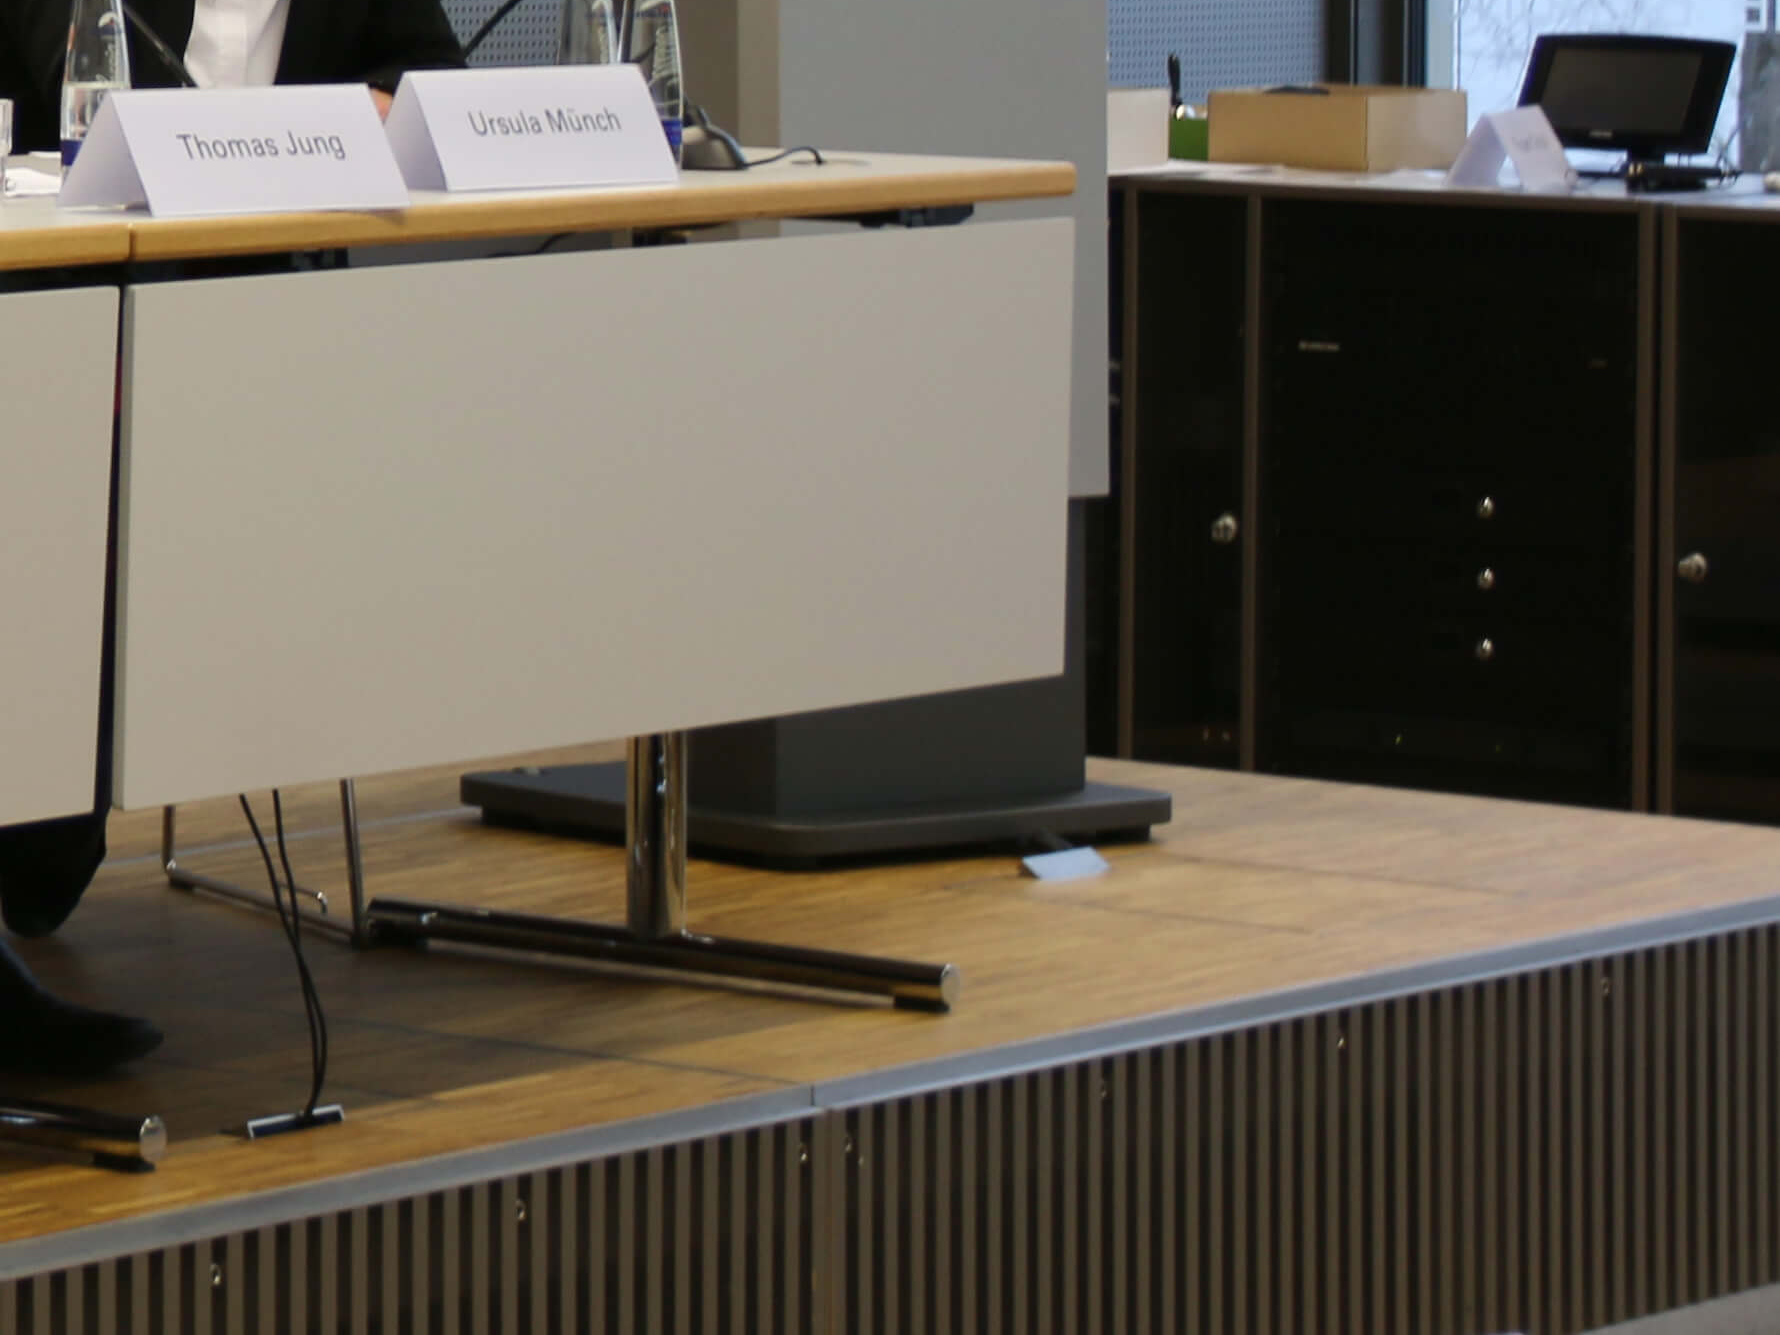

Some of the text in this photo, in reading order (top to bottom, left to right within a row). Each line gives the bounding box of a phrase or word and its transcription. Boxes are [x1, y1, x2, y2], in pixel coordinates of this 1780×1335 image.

[468, 106, 623, 137] Ursula Münch
[176, 130, 346, 160] Thomas Jung
